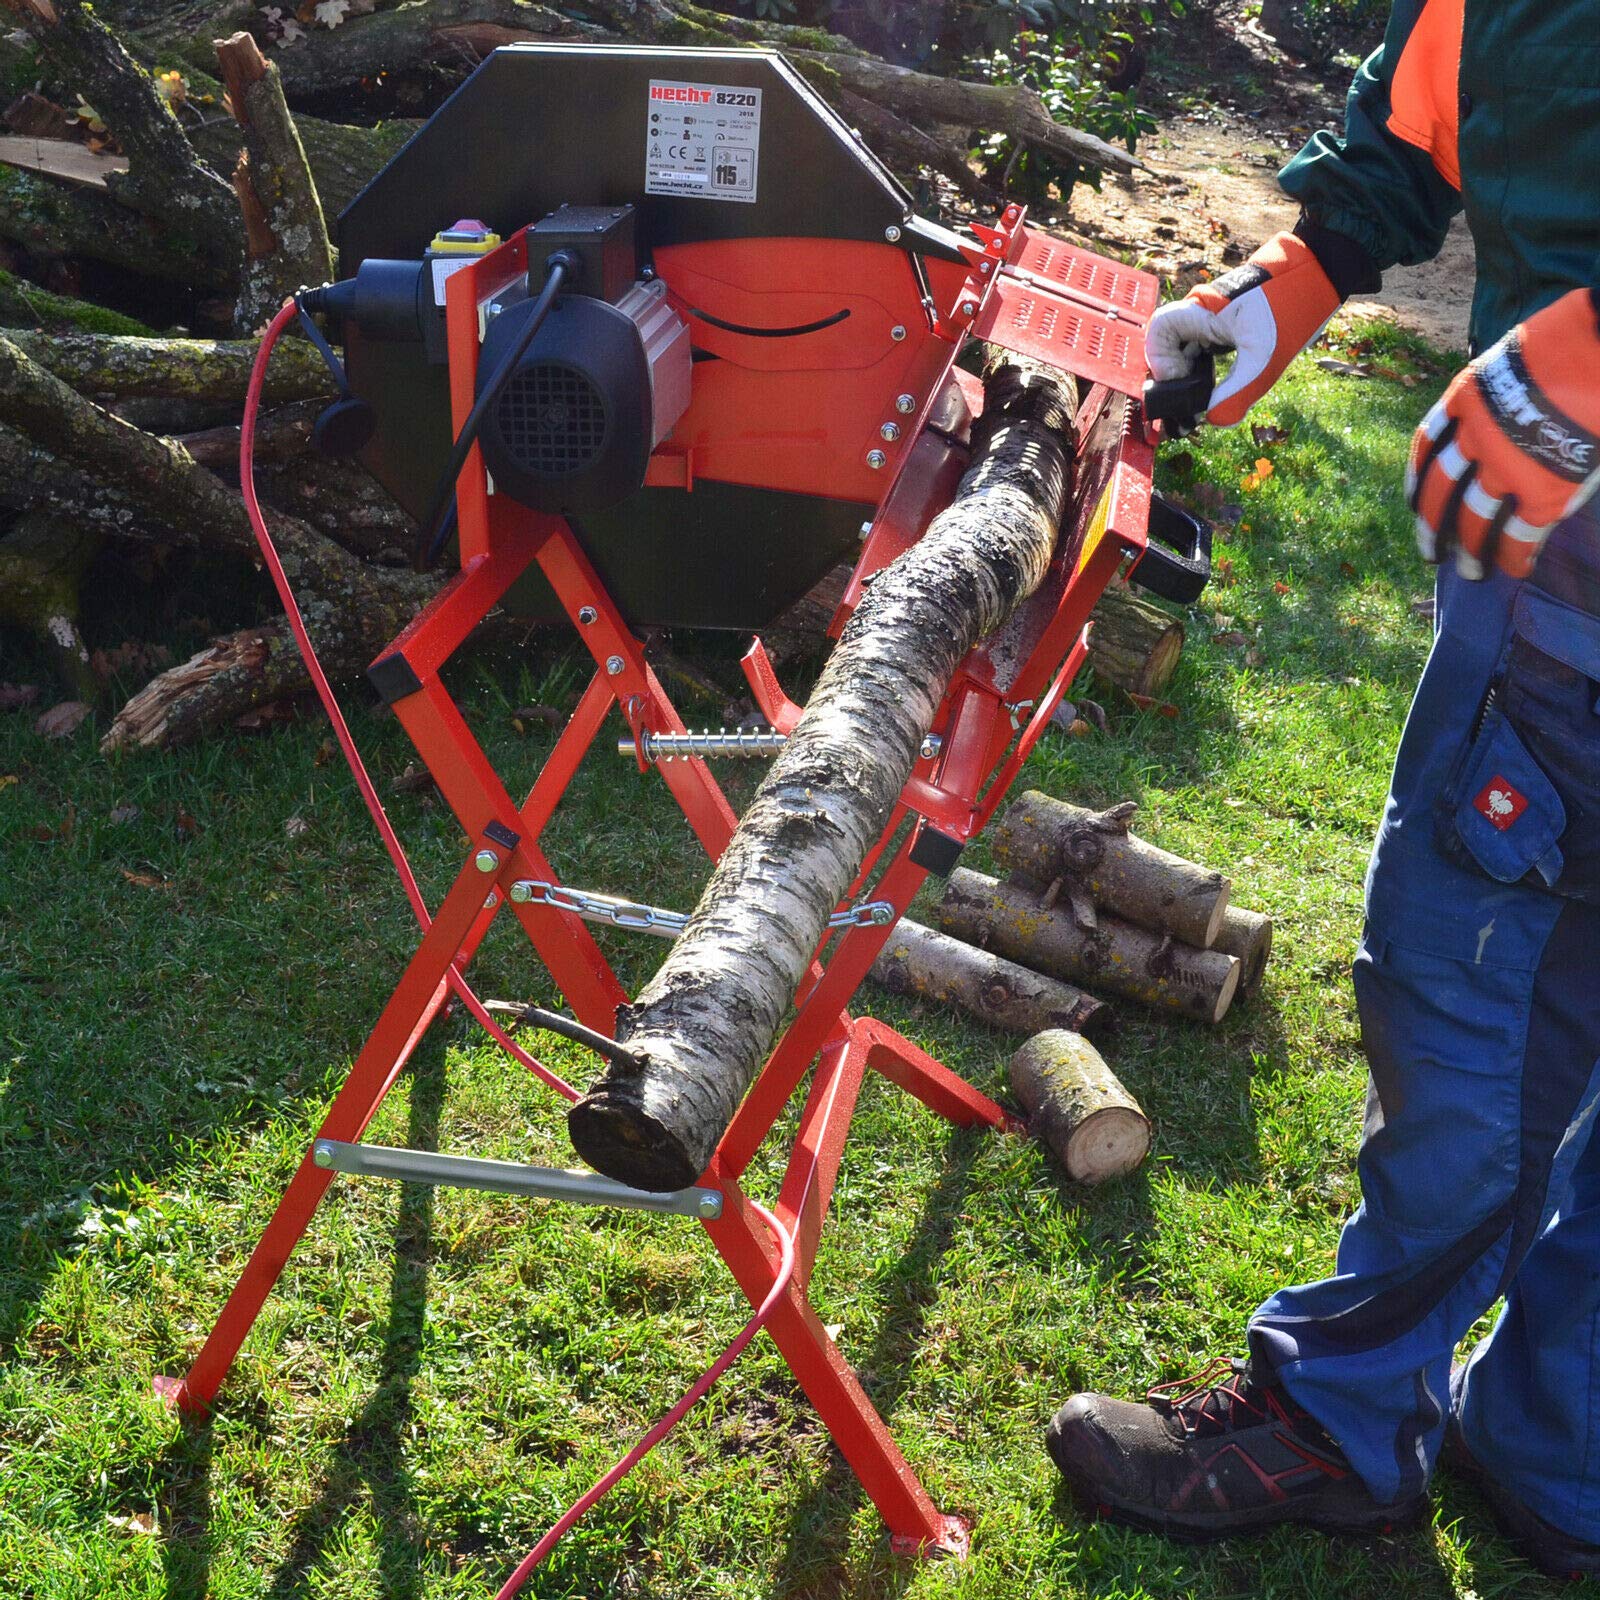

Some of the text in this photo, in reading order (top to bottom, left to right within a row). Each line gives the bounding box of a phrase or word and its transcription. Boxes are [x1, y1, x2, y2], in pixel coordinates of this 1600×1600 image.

[716, 93, 756, 106] 8220
[669, 145, 687, 160] CE
[716, 165, 737, 185] 115
[650, 181, 703, 190] www.hecht.cz
